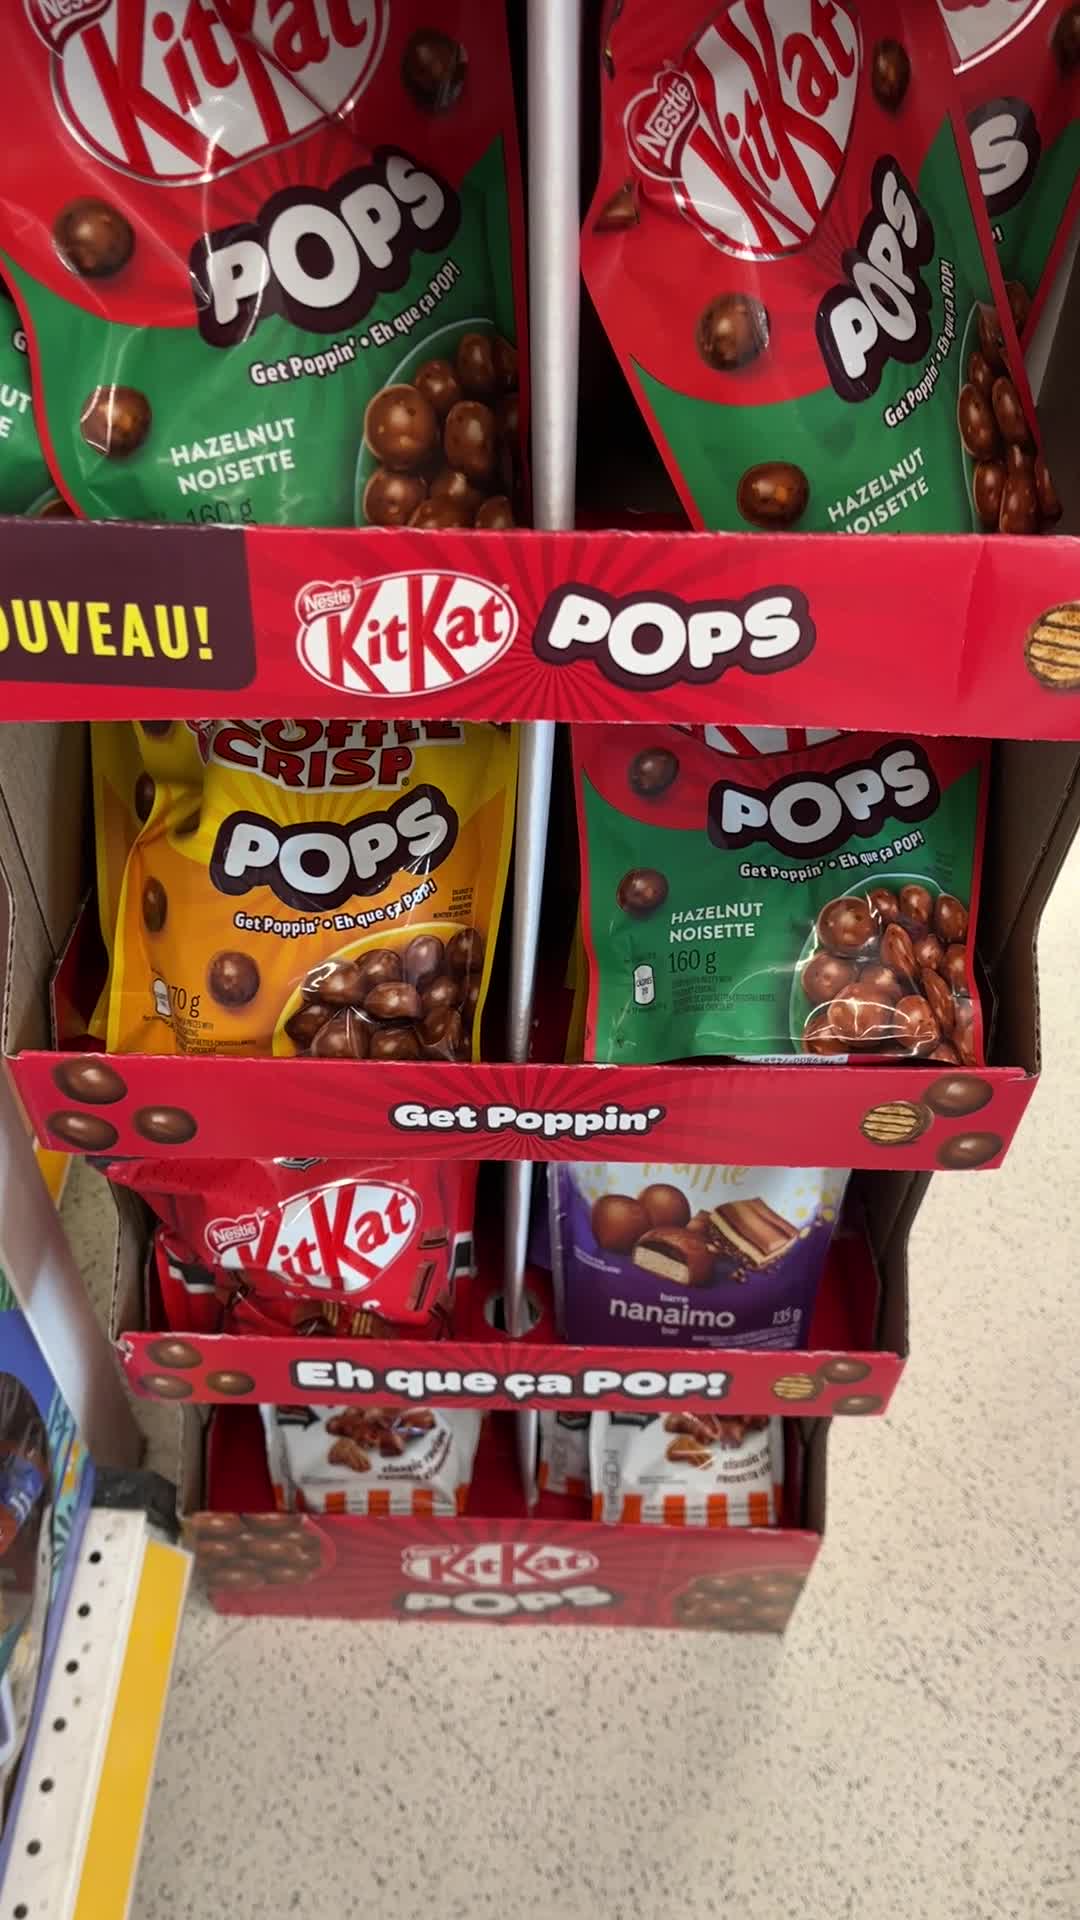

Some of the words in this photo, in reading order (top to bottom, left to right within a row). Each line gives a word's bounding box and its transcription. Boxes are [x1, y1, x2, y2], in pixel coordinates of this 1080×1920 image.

[637, 79, 692, 158] Nestlé
[206, 156, 445, 324] POPS
[830, 170, 918, 380] POPS
[940, 259, 955, 299] POP!
[251, 363, 288, 384] Get
[289, 338, 355, 376] Poppin'
[369, 322, 394, 346] Eh
[394, 307, 422, 335] que
[419, 294, 436, 315] ça
[429, 259, 461, 299] POP!
[944, 312, 956, 339] que
[936, 334, 951, 356] Eh
[906, 359, 938, 402] Poppin'
[884, 399, 910, 427] Get
[170, 418, 296, 467] HAZELNUT
[177, 449, 296, 495] NOISETTE
[827, 447, 924, 523] HAZELNUT
[187, 501, 229, 525] 160
[240, 498, 257, 525] g
[0, 599, 214, 660] UVEAU!
[326, 574, 503, 693] KitKat
[547, 594, 800, 675] POPS
[213, 727, 412, 787] CRISP
[721, 750, 930, 844] POPS
[224, 796, 449, 895] POPS
[740, 863, 767, 878] Get
[770, 862, 824, 882] Poppin'
[840, 853, 859, 869] Eh
[860, 850, 879, 865] que
[879, 847, 894, 863] ça
[894, 831, 924, 854] POP!
[235, 913, 261, 930] Get
[264, 918, 320, 938] Poppin'
[335, 914, 353, 930] Eh
[357, 910, 384, 928] que
[403, 880, 437, 910] POP!
[671, 903, 763, 923] HAZELNUT
[669, 922, 756, 943] NOISETTE
[668, 950, 700, 973] 160
[706, 951, 716, 974] g
[168, 985, 187, 1010] 70
[190, 994, 200, 1018] g
[394, 1104, 477, 1128] Get
[487, 1106, 660, 1136] Poppin'
[237, 1184, 411, 1290] KitKat
[609, 1299, 736, 1328] nanaimo
[296, 1361, 373, 1389] Eh
[386, 1368, 498, 1397] que
[504, 1373, 571, 1399] ça
[583, 1371, 726, 1396] POP!
[430, 1544, 583, 1584] KitKat
[405, 1585, 612, 1613] POPS
